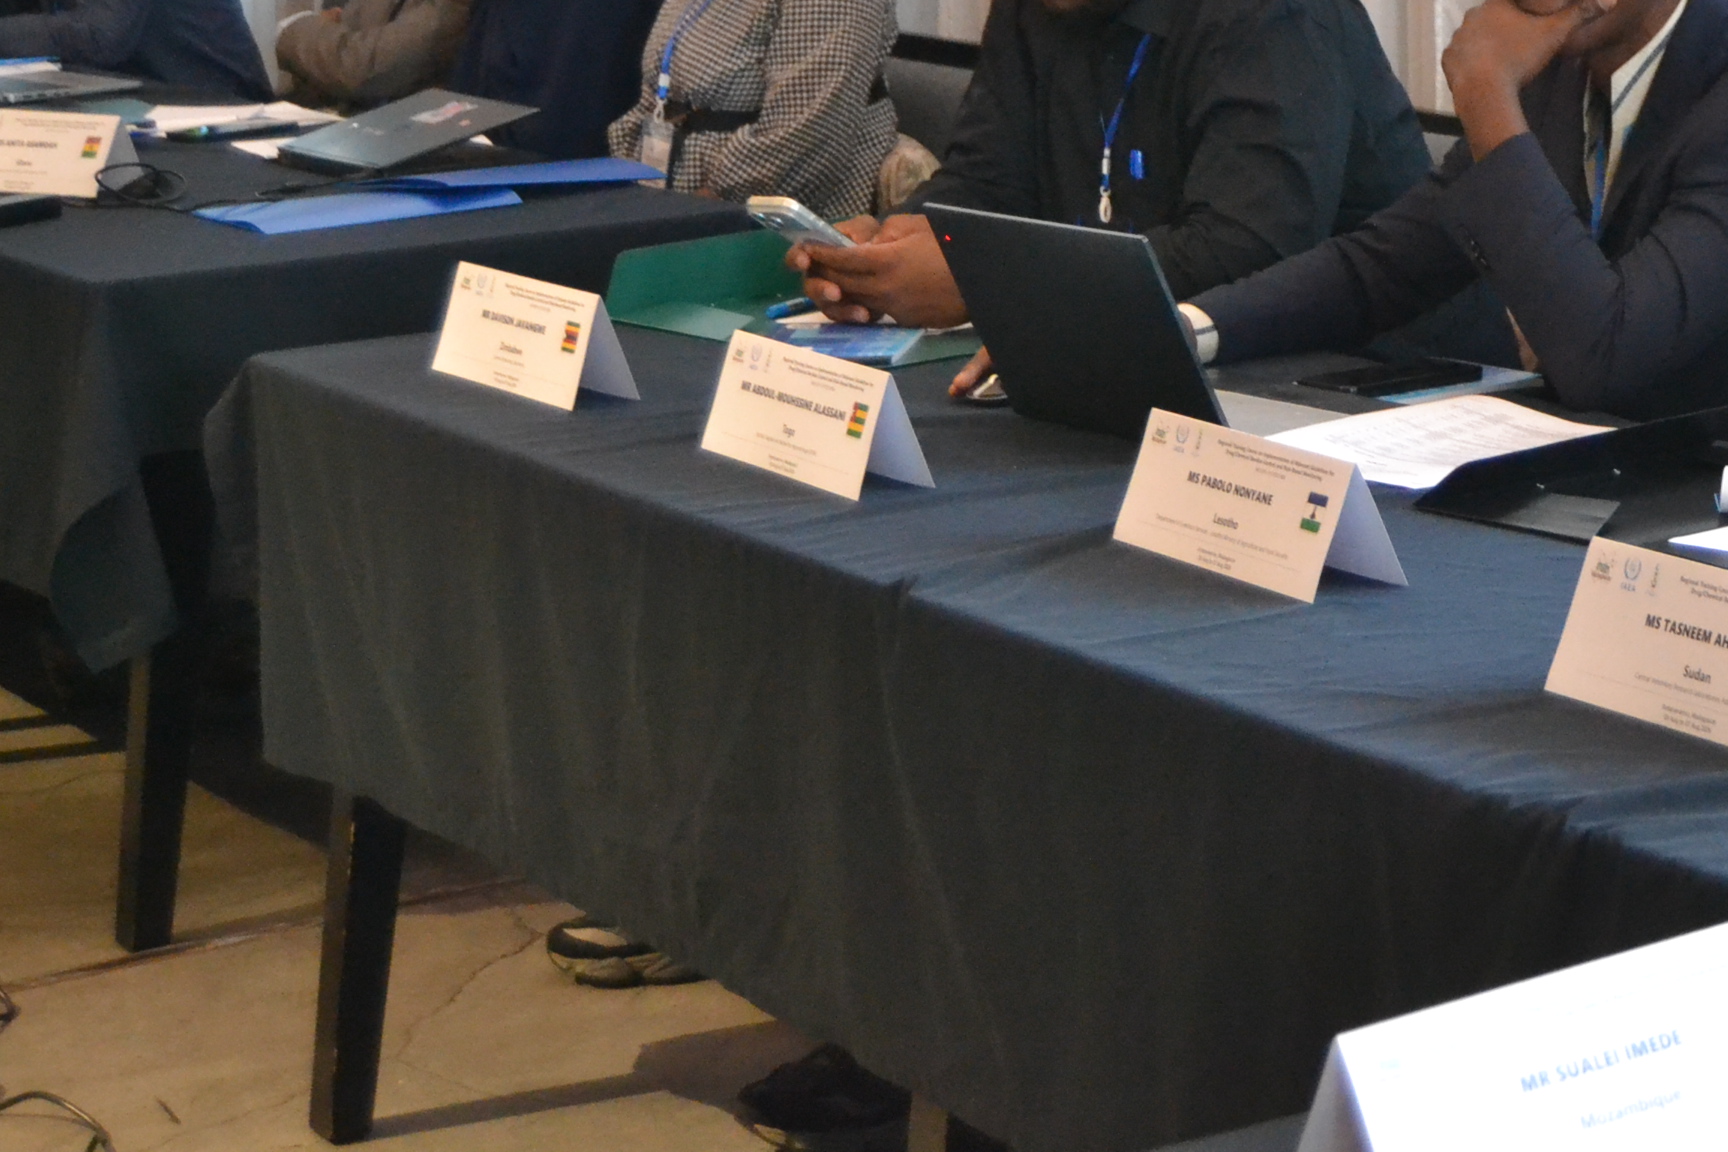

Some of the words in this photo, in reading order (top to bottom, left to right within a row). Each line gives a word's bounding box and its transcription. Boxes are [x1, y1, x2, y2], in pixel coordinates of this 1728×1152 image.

[1187, 470, 1200, 483] MS
[1201, 474, 1233, 494] PABOLO
[1234, 484, 1274, 506] NONYANE
[1212, 513, 1239, 530] Lesotho
[1645, 613, 1662, 630] MS
[1664, 618, 1713, 644] TASNEEM
[1683, 665, 1712, 684] Sudan
[1520, 1067, 1551, 1094] MR
[1554, 1046, 1621, 1084] SUALEI
[1623, 1027, 1683, 1061] IMEDE
[1579, 1088, 1683, 1131] Mozambique
